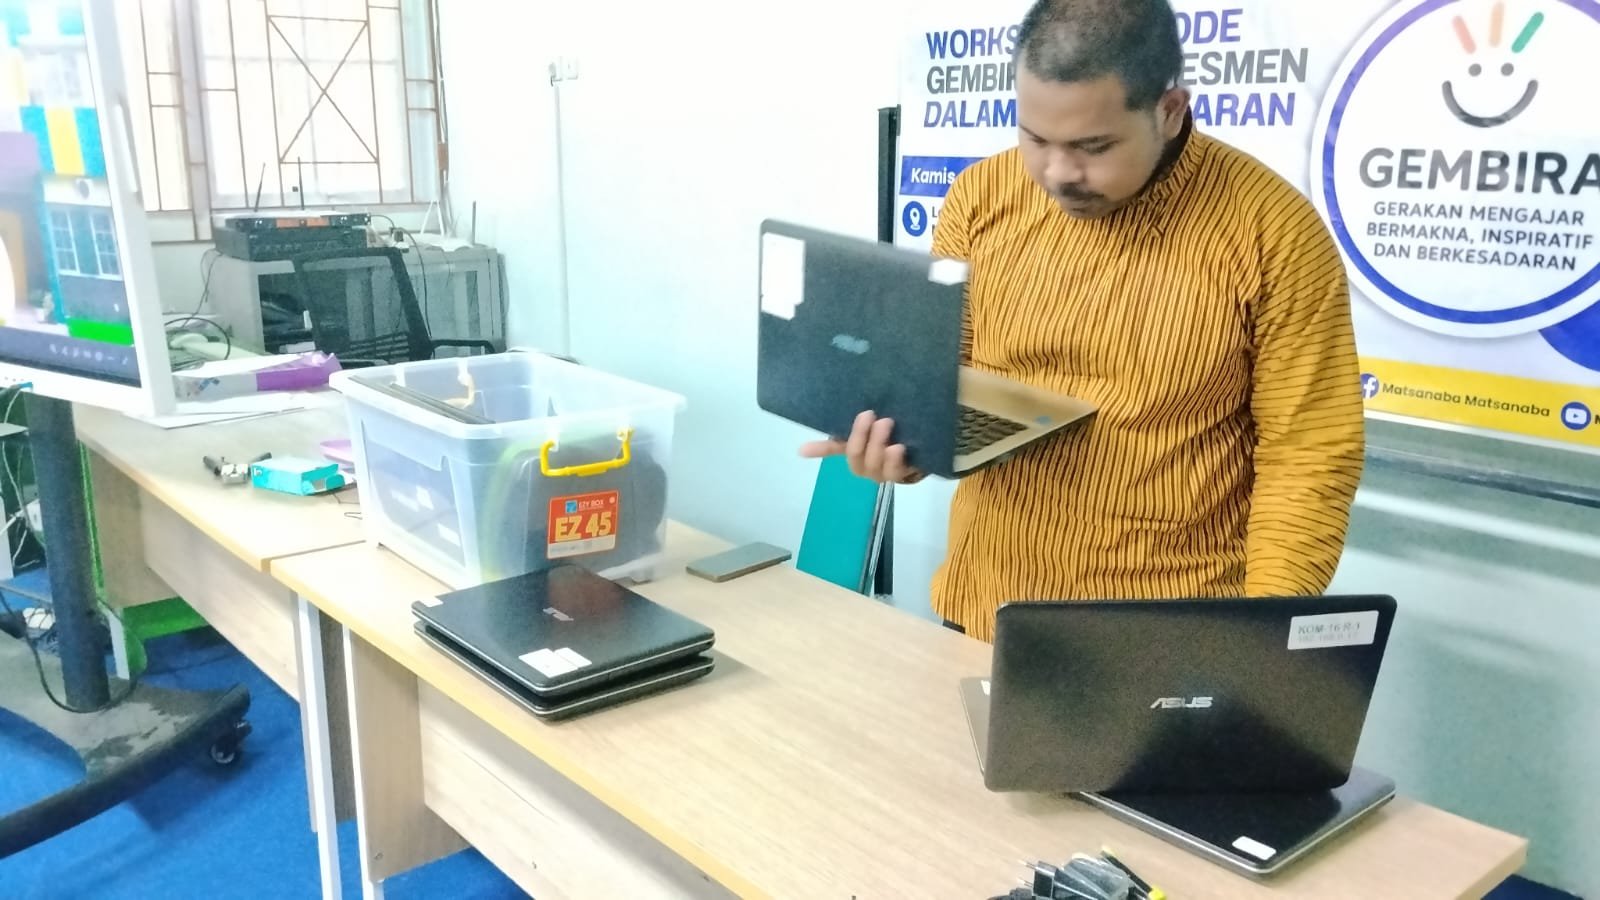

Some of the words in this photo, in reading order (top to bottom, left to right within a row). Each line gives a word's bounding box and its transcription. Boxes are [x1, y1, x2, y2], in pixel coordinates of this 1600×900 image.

[926, 24, 1021, 59] WORKS
[1175, 8, 1243, 45] ODE
[926, 61, 1017, 94] GEMBIR
[1182, 47, 1309, 86] ESMEN
[923, 98, 1018, 128] DALAM
[1193, 91, 1296, 127] ARAN
[1358, 147, 1600, 195] GEMBIRA
[1373, 201, 1463, 219] GERAKAN
[1469, 205, 1585, 226] MENGAJAR
[1366, 222, 1475, 244] BERMAKNA,
[1481, 228, 1594, 249] INSPIRATIF
[1373, 242, 1411, 260] DAN
[1416, 245, 1577, 271] BERKESADARAN
[1382, 382, 1461, 404] Matsanaba
[1464, 395, 1551, 417] Matsanaba
[555, 515, 583, 541] EZ
[585, 511, 612, 537] 45
[1150, 696, 1214, 709] ASUS
